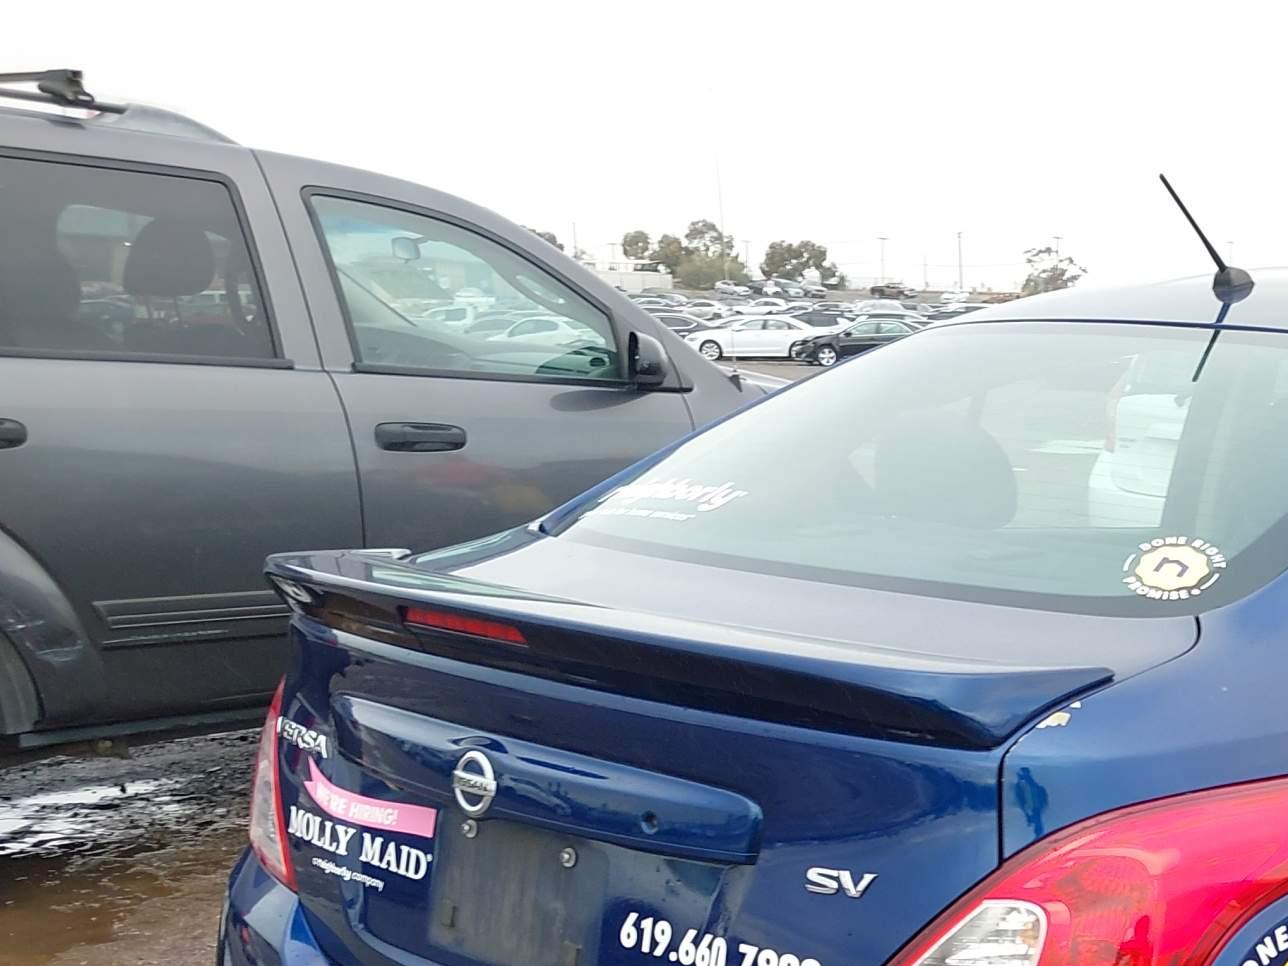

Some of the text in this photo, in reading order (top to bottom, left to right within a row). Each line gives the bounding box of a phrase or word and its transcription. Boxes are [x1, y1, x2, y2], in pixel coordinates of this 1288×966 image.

[1138, 536, 1227, 568] DONE RIGHT
[276, 715, 328, 759] VERSA
[288, 806, 356, 856] MOLLY
[804, 866, 878, 899] SV
